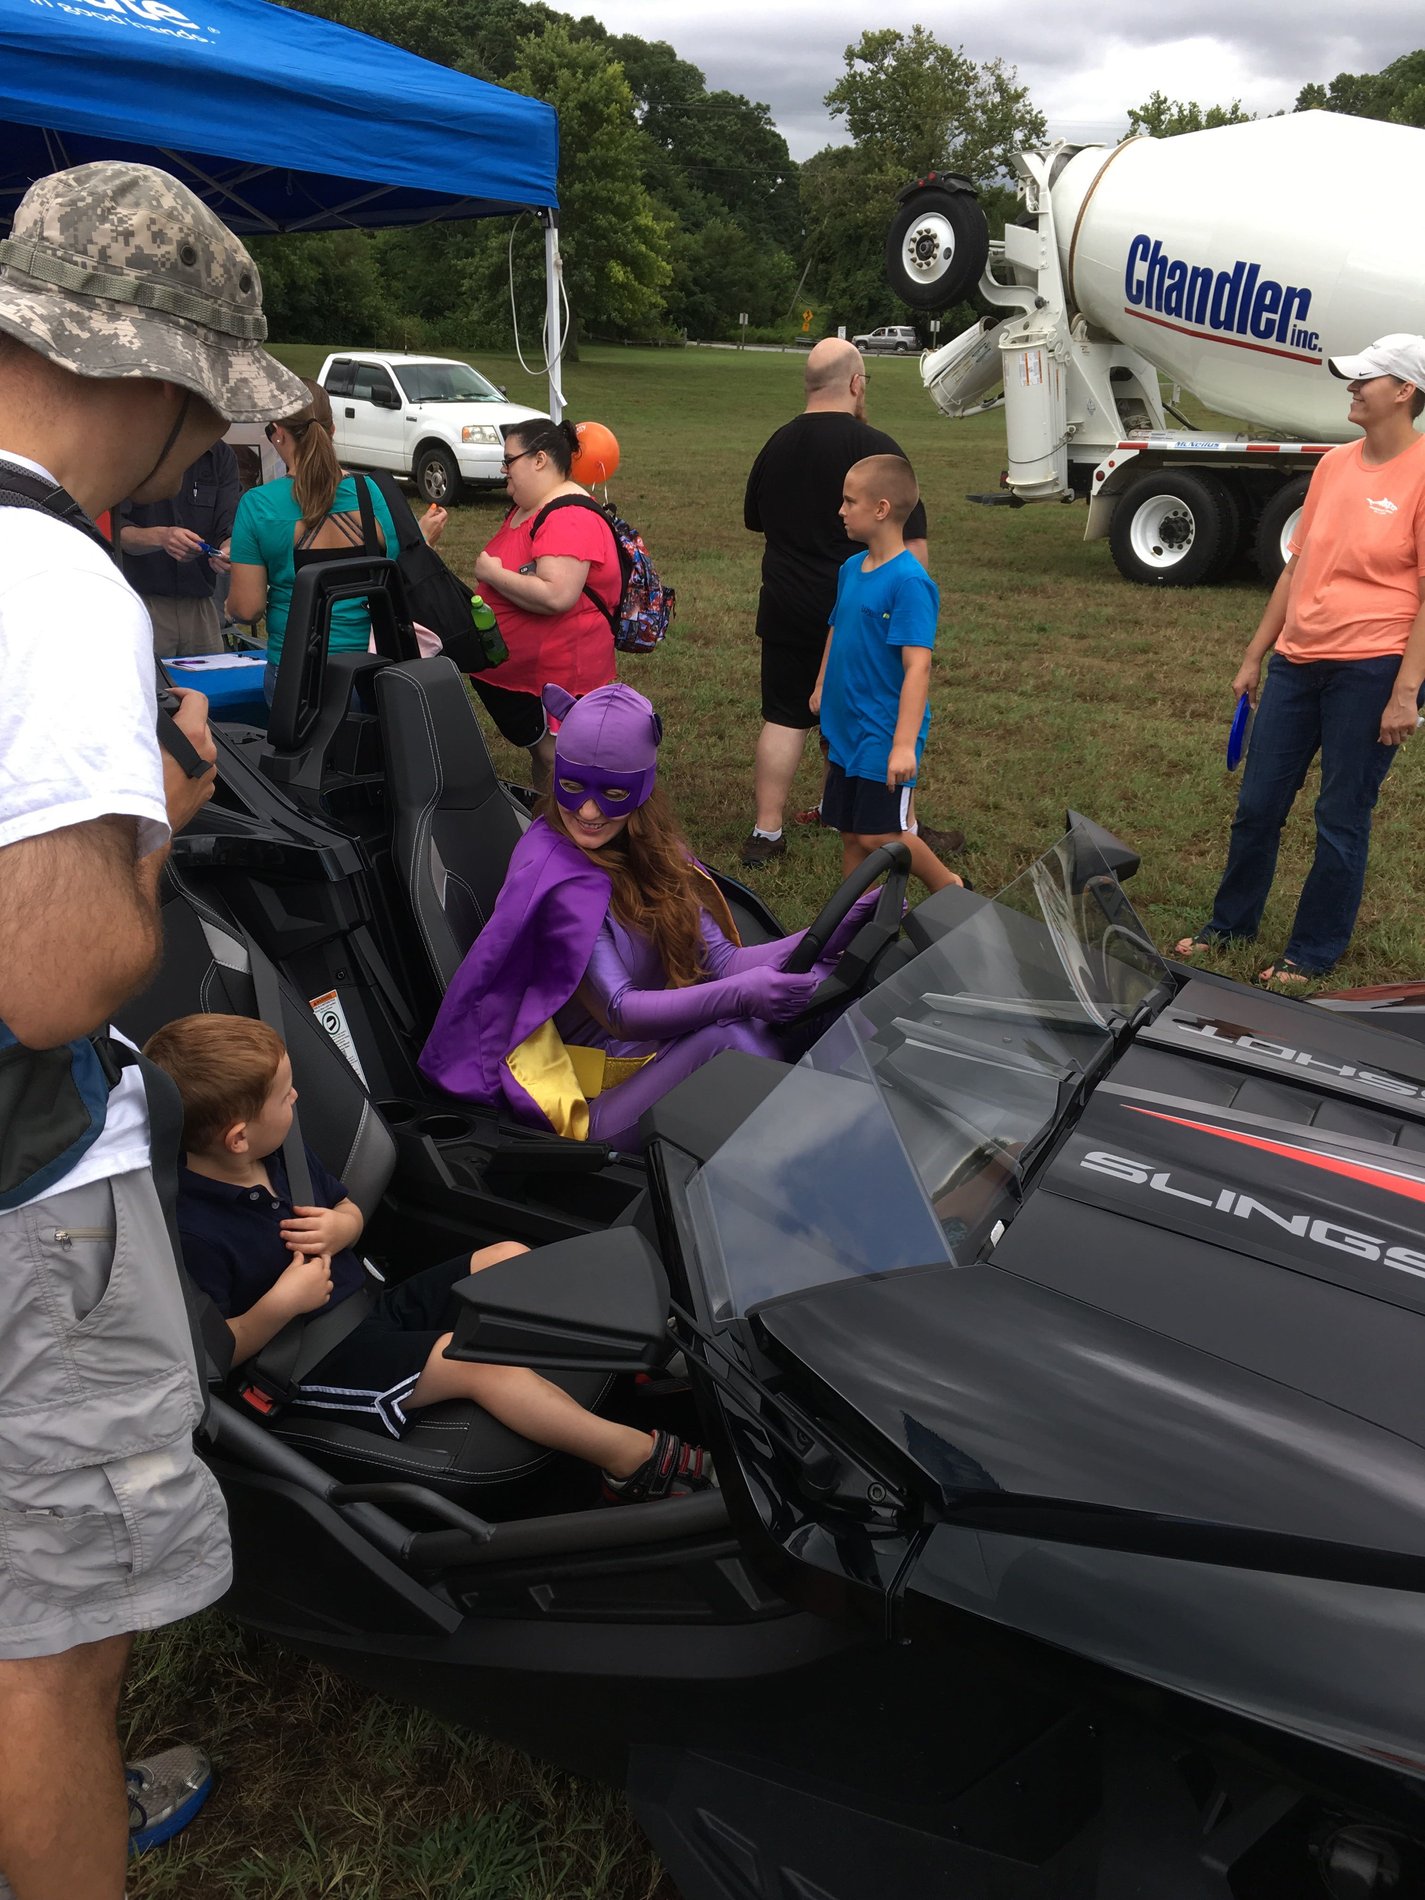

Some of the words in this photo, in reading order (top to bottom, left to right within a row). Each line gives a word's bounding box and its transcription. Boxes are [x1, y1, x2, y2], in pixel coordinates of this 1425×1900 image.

[57, 3, 128, 25] good
[124, 18, 217, 44] hands.
[1125, 234, 1312, 344] Chandler
[1290, 324, 1323, 352] inc.
[1177, 1025, 1425, 1102] SHOT
